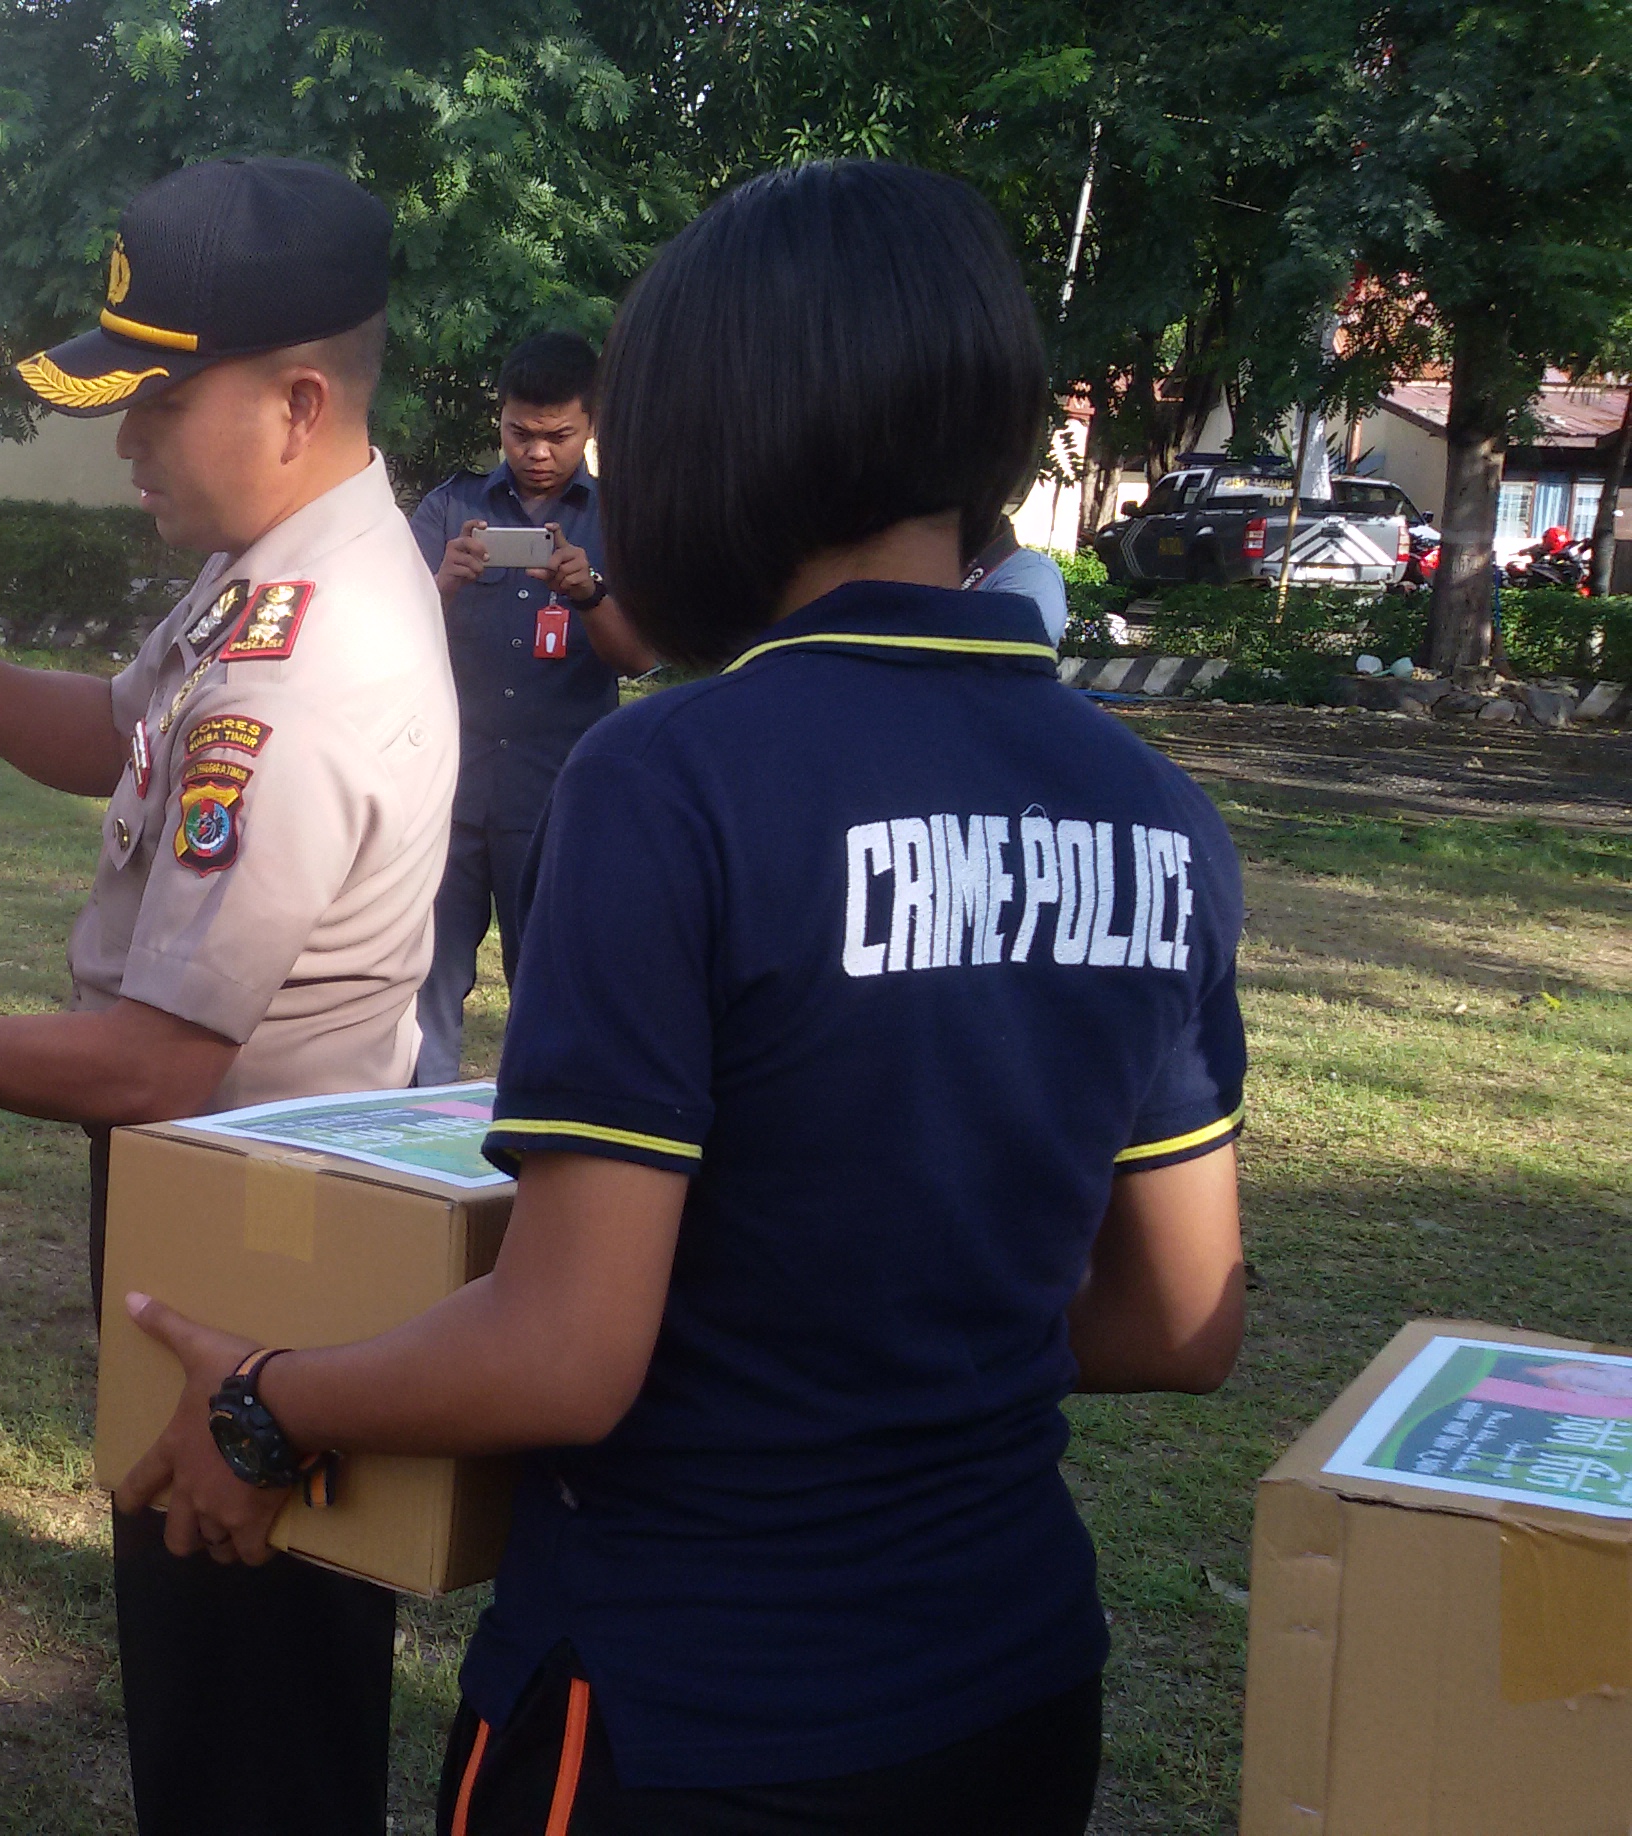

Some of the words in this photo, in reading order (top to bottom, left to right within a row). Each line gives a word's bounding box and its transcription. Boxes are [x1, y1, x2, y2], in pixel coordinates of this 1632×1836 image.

[190, 719, 261, 740] POLRES
[224, 730, 259, 749] TIMUR
[842, 813, 1014, 978] CRIME
[1010, 816, 1193, 971] POLICE
